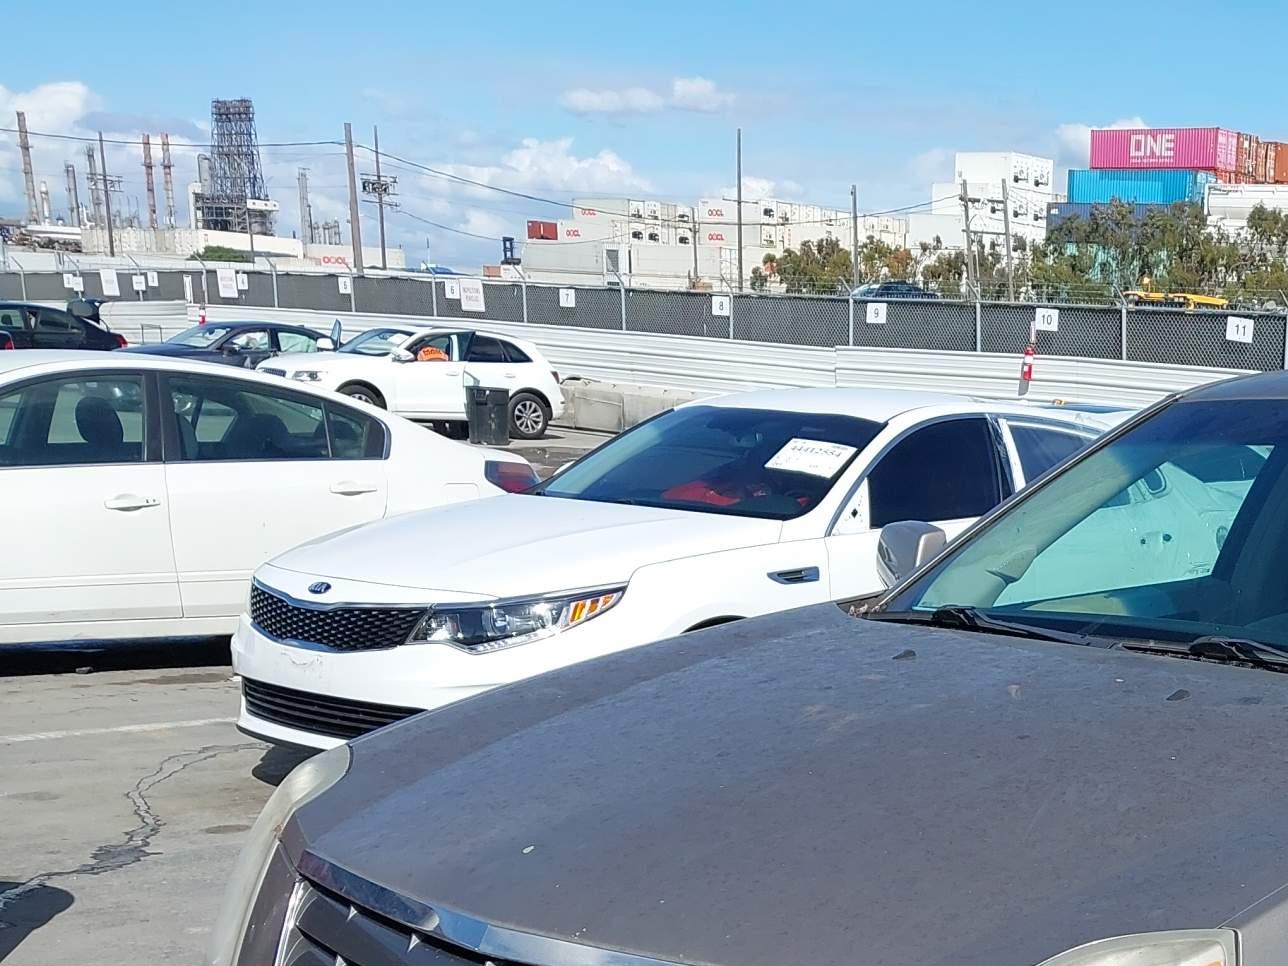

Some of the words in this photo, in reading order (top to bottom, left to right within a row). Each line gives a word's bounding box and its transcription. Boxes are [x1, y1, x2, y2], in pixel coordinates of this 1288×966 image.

[1130, 133, 1175, 157] ONE
[708, 208, 724, 217] OOCL
[566, 229, 580, 238] OOCL
[708, 233, 724, 241] OOCL
[564, 293, 570, 304] 7
[718, 301, 724, 311] 8
[873, 308, 879, 319] 9
[1041, 313, 1053, 326] 10
[1234, 323, 1247, 337] 11
